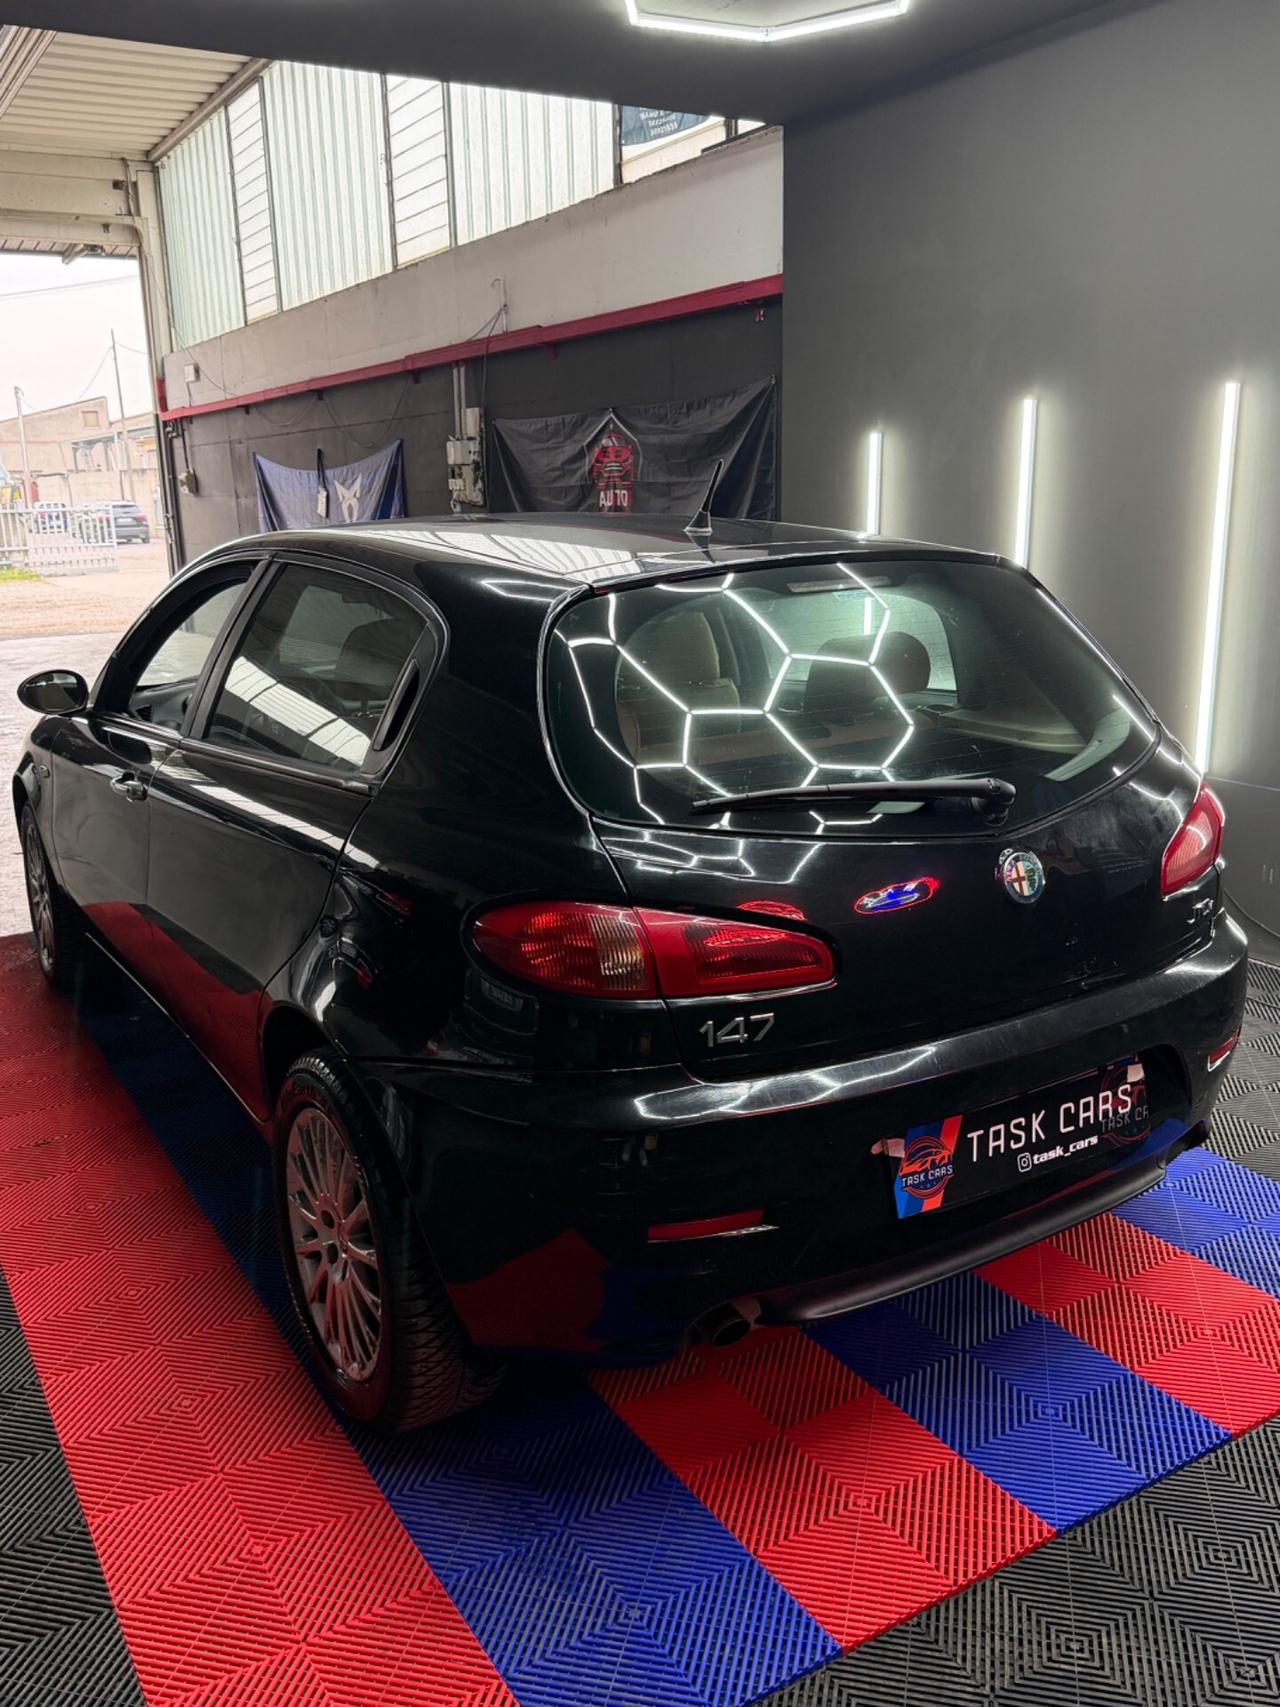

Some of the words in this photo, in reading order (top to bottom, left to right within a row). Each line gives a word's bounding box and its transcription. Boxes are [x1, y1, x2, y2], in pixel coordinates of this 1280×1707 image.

[599, 489, 629, 508] AUTO
[699, 1012, 775, 1048] 147
[966, 1109, 1046, 1162] TASK
[1059, 1083, 1132, 1134] CARS
[1100, 1112, 1131, 1133] TASK
[1033, 1135, 1099, 1165] task_cars
[902, 1172, 926, 1188] TASK
[928, 1164, 953, 1180] CARS
